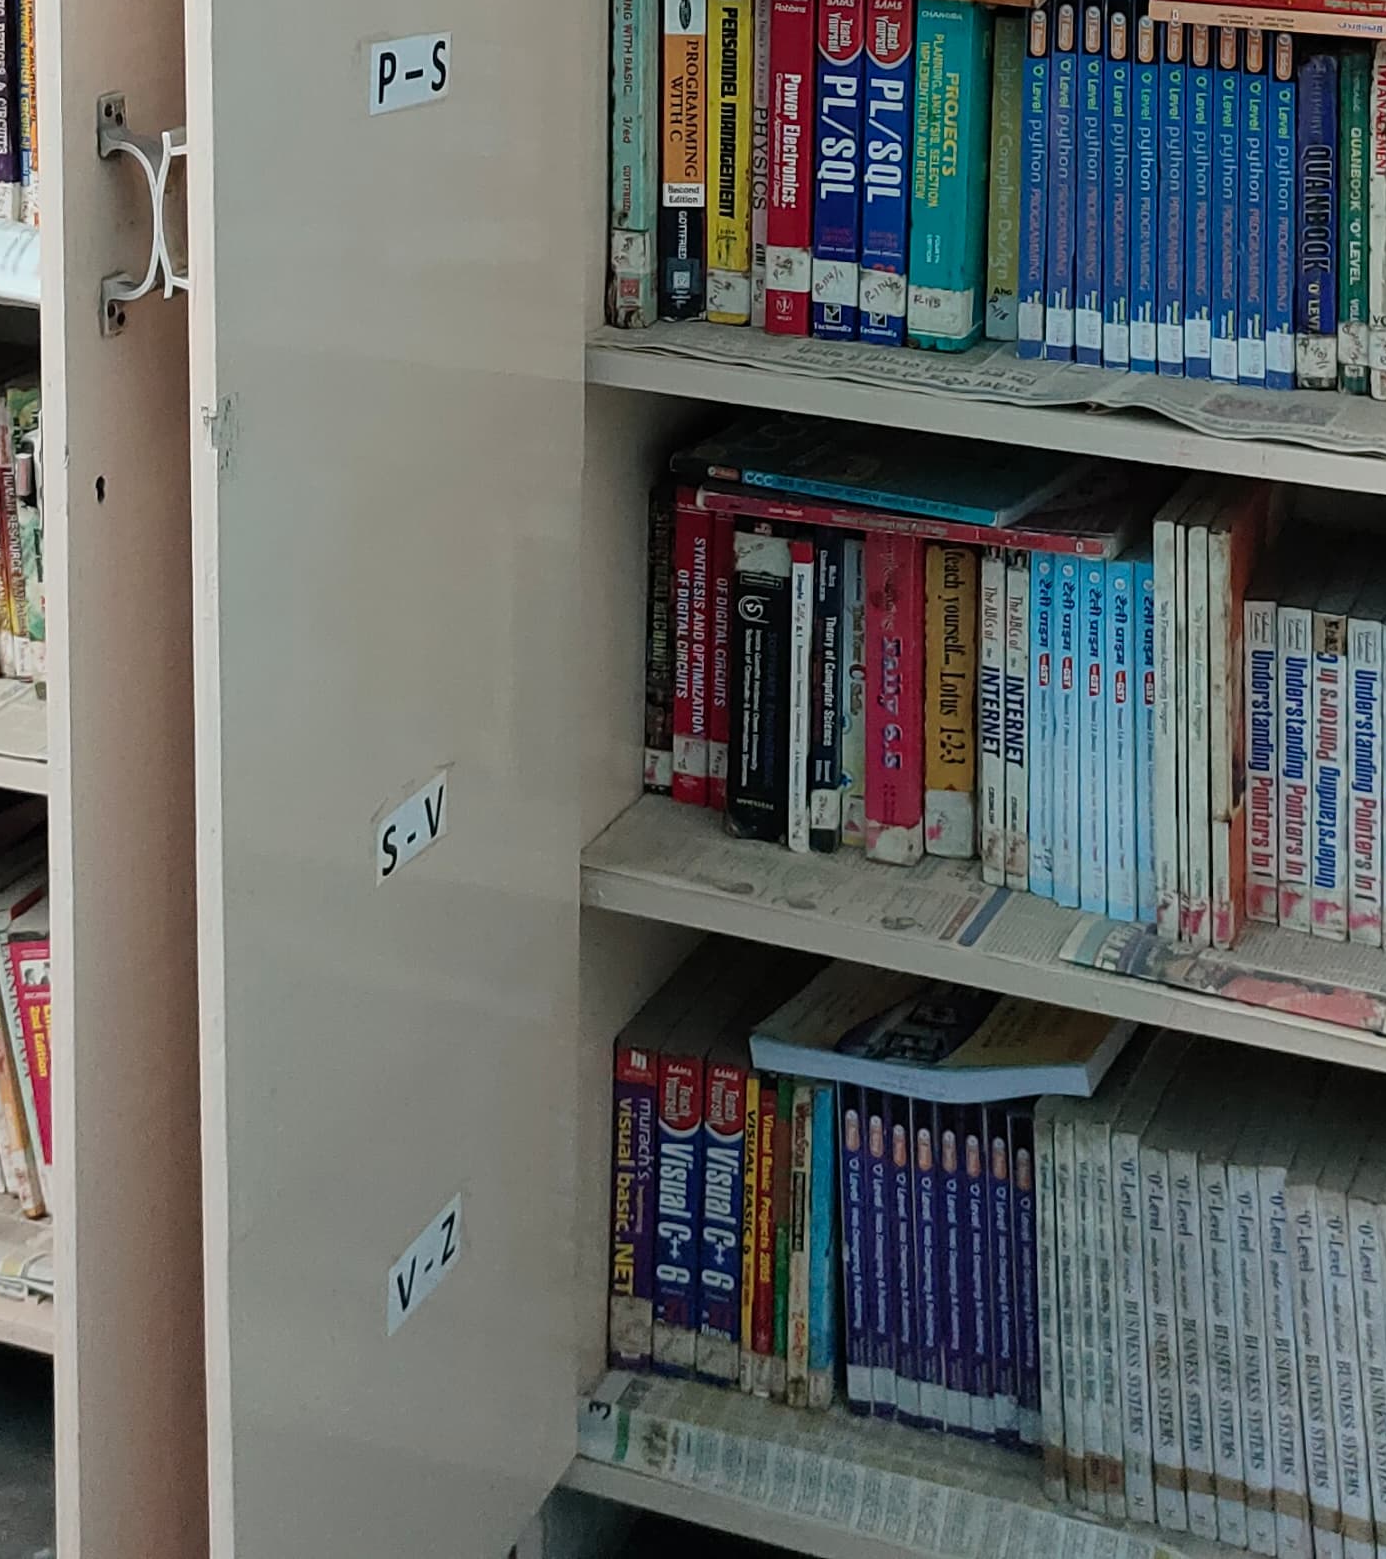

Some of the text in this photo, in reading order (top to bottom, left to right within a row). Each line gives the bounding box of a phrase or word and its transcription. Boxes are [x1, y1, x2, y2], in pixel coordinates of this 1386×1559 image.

[873, 0, 903, 10] SAMS
[668, 76, 684, 123] WITH
[684, 40, 700, 179] PROGRAMMING
[819, 75, 858, 202] PL/SQL
[866, 78, 905, 205] PL/SQL
[940, 72, 960, 178] PROJECTS
[753, 106, 770, 211] PHYSICS
[981, 665, 1000, 758] INTERNET
[1248, 650, 1276, 772] Understanding
[1283, 656, 1308, 779] Understanding
[659, 1143, 695, 1218] Visual
